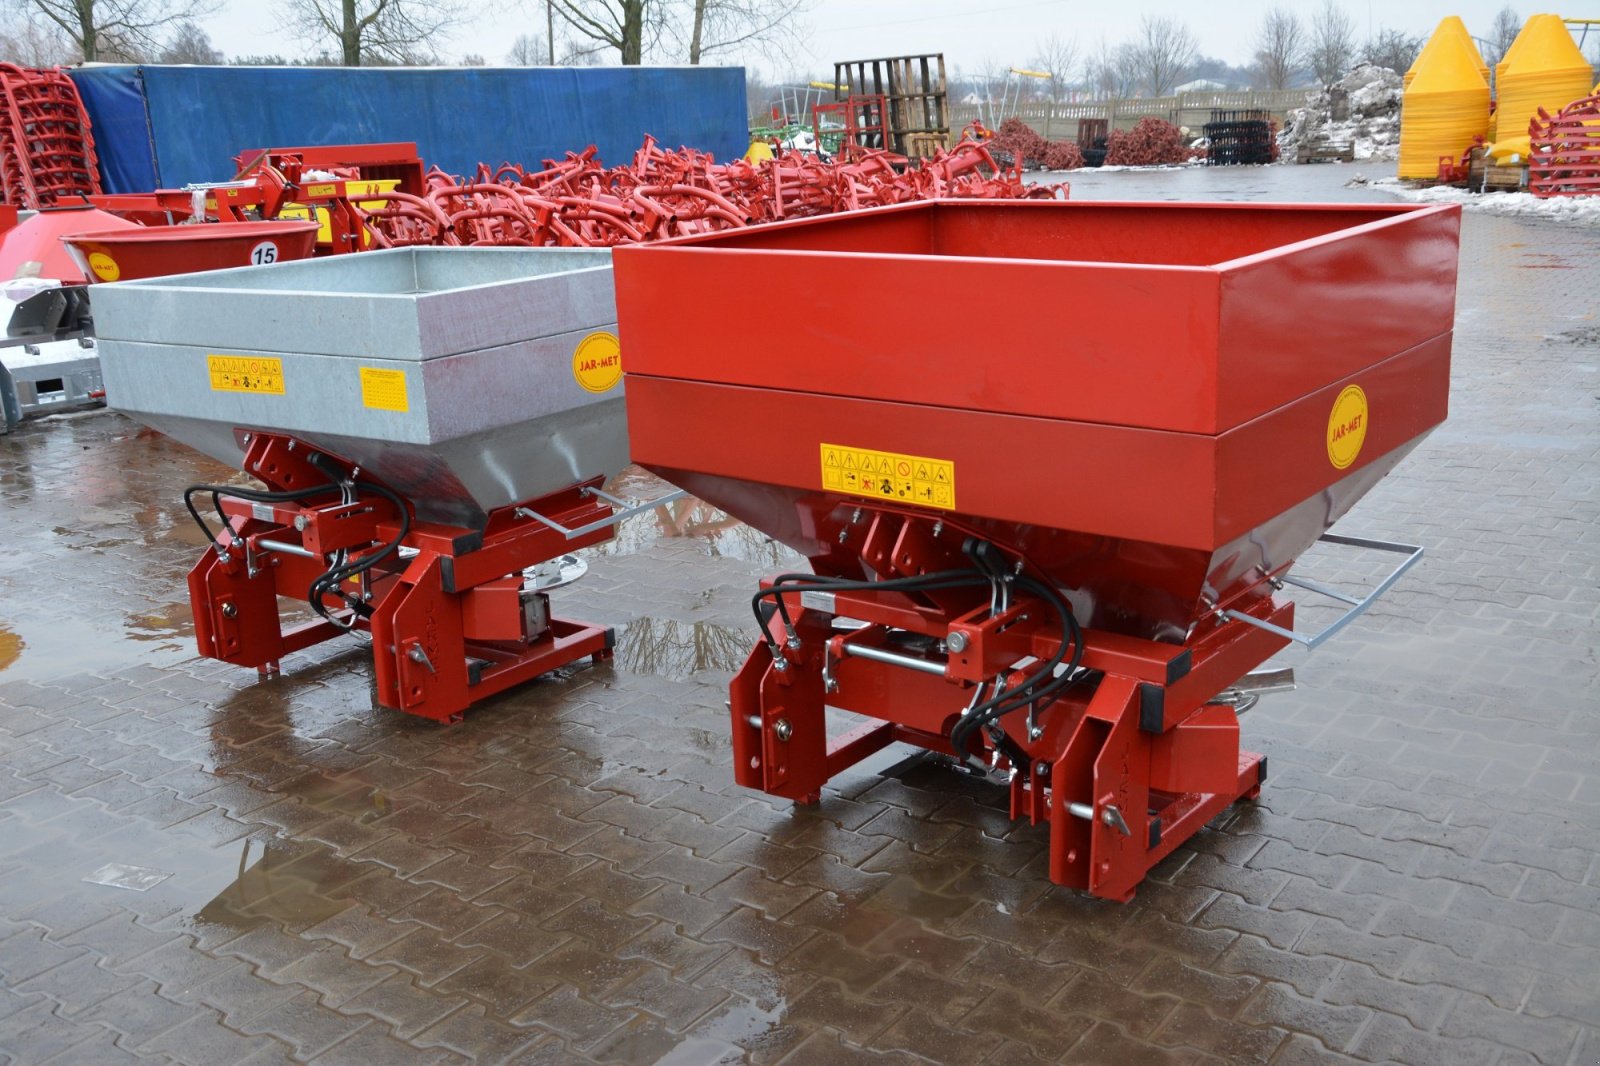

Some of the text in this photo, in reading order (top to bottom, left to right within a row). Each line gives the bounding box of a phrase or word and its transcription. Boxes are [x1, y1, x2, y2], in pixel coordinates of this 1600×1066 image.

[254, 247, 275, 265] 15
[579, 355, 619, 371] JAR-MET
[1332, 414, 1362, 443] JAR-MET
[1116, 741, 1129, 852] JARMT
